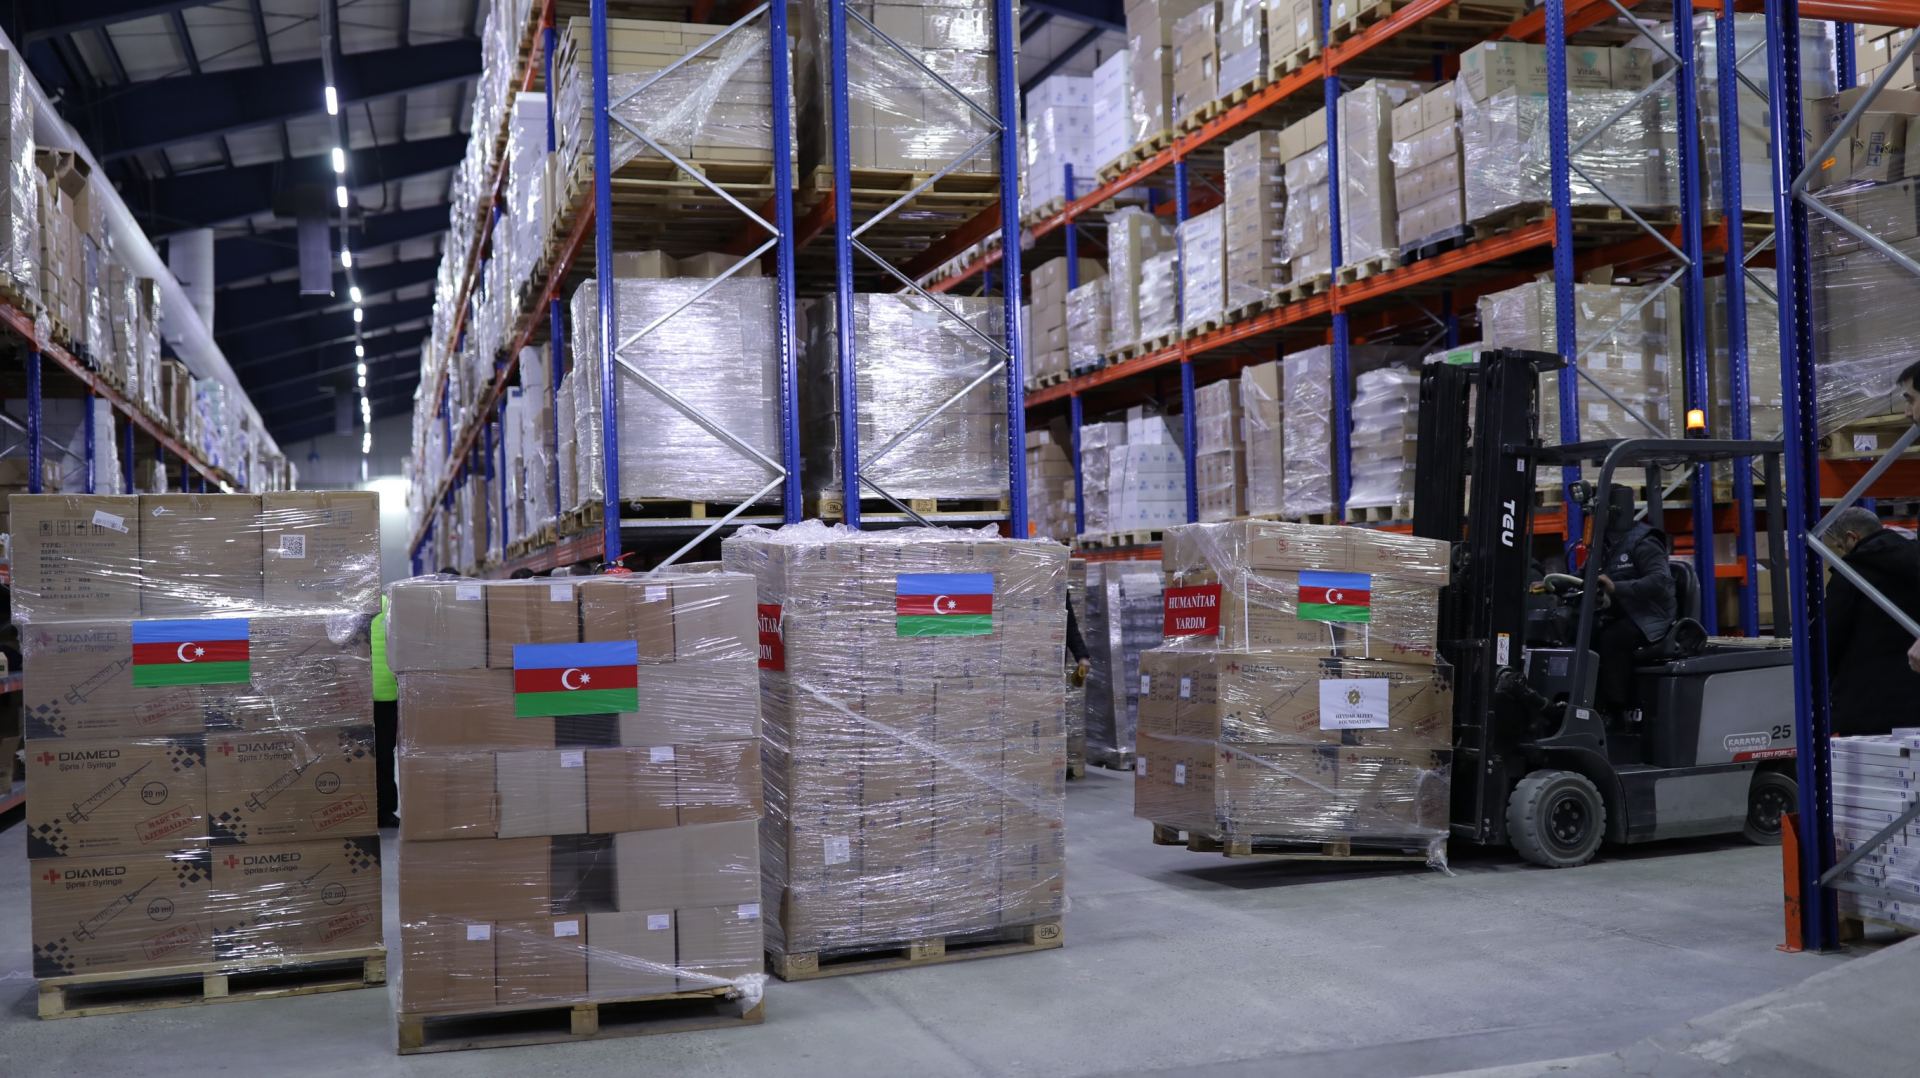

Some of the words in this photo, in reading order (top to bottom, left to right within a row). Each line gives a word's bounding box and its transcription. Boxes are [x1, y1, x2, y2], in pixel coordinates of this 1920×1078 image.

[1502, 499, 1516, 547] TEU
[1169, 592, 1216, 609] HUMANİTAR
[1176, 616, 1206, 630] YARDIM
[56, 631, 118, 644] DIAMED
[1364, 670, 1404, 680] DIAMED
[1771, 724, 1791, 740] 25
[237, 741, 296, 753] DIAMED
[59, 750, 120, 762] DIAMED
[1751, 751, 1774, 759] BATTERY
[87, 761, 116, 770] Syringe
[243, 852, 301, 866] DIAMED
[65, 866, 126, 880] DIAMED
[93, 878, 122, 888] Syringe
[151, 906, 160, 914] 20
[1040, 926, 1057, 937] EPAL
